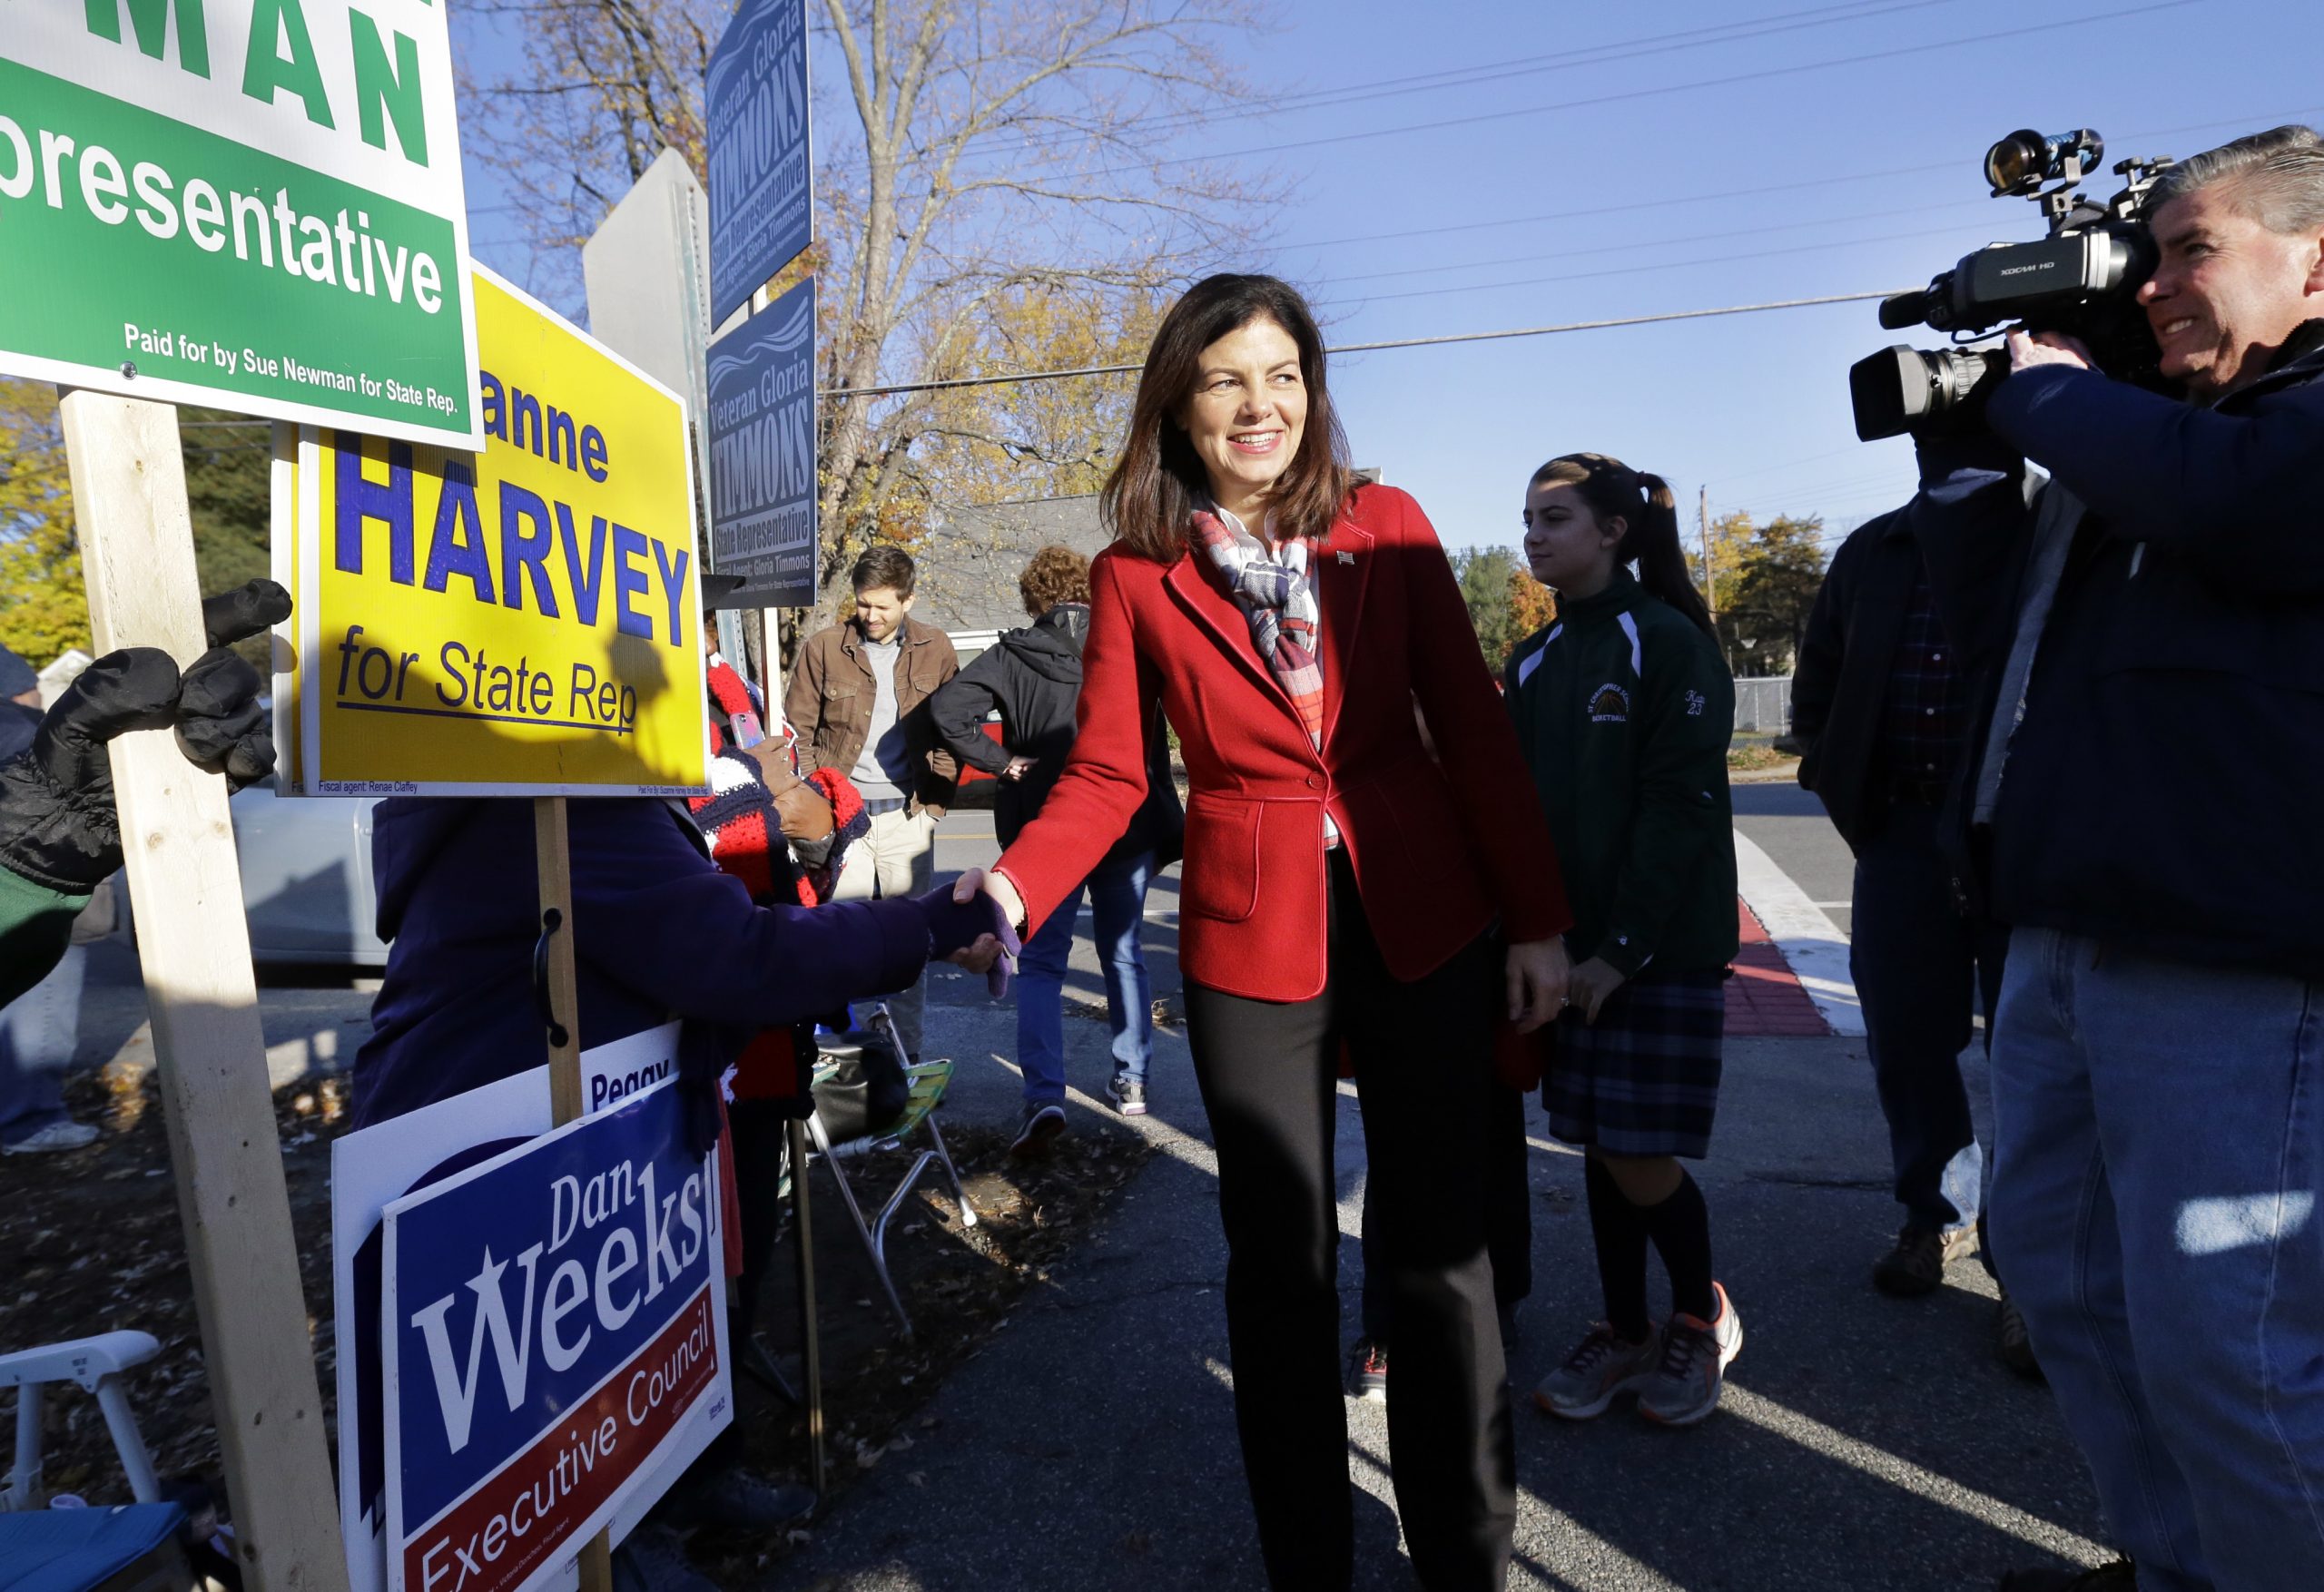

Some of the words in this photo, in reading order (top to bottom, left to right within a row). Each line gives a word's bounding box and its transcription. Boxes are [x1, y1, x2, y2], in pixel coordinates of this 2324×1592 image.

[753, 0, 801, 81] Gloria
[710, 35, 803, 236] TIMMONS
[730, 152, 803, 251] Representative
[747, 230, 768, 261] Gloria
[769, 195, 806, 241] Timmons
[2039, 261, 2055, 270] HD
[123, 323, 172, 357] Paid
[179, 335, 207, 363] for
[213, 342, 237, 375] by
[243, 349, 278, 378] Sue
[284, 357, 356, 393] Newman
[359, 373, 382, 398] for
[387, 379, 423, 407] State
[428, 387, 458, 416] Rep.
[710, 387, 757, 434] Veteran
[761, 350, 809, 408] Gloria
[481, 370, 608, 483] anne
[712, 396, 810, 520] TIMMONS
[334, 428, 689, 647] HARVEY
[715, 526, 735, 558] State
[736, 507, 808, 554] Representative
[753, 557, 773, 575] Gloria
[774, 554, 810, 573] Timmons
[337, 625, 419, 701] for
[436, 641, 553, 715] State
[570, 663, 636, 736] Rep
[1687, 703, 1702, 715] 23
[319, 781, 341, 791] Fiscal
[343, 781, 367, 794] agent:
[369, 781, 392, 792] Renae
[547, 1158, 636, 1255] Dan
[411, 1160, 703, 1455] Weeks
[422, 1417, 617, 1592] Executive
[627, 1301, 708, 1425] Council
